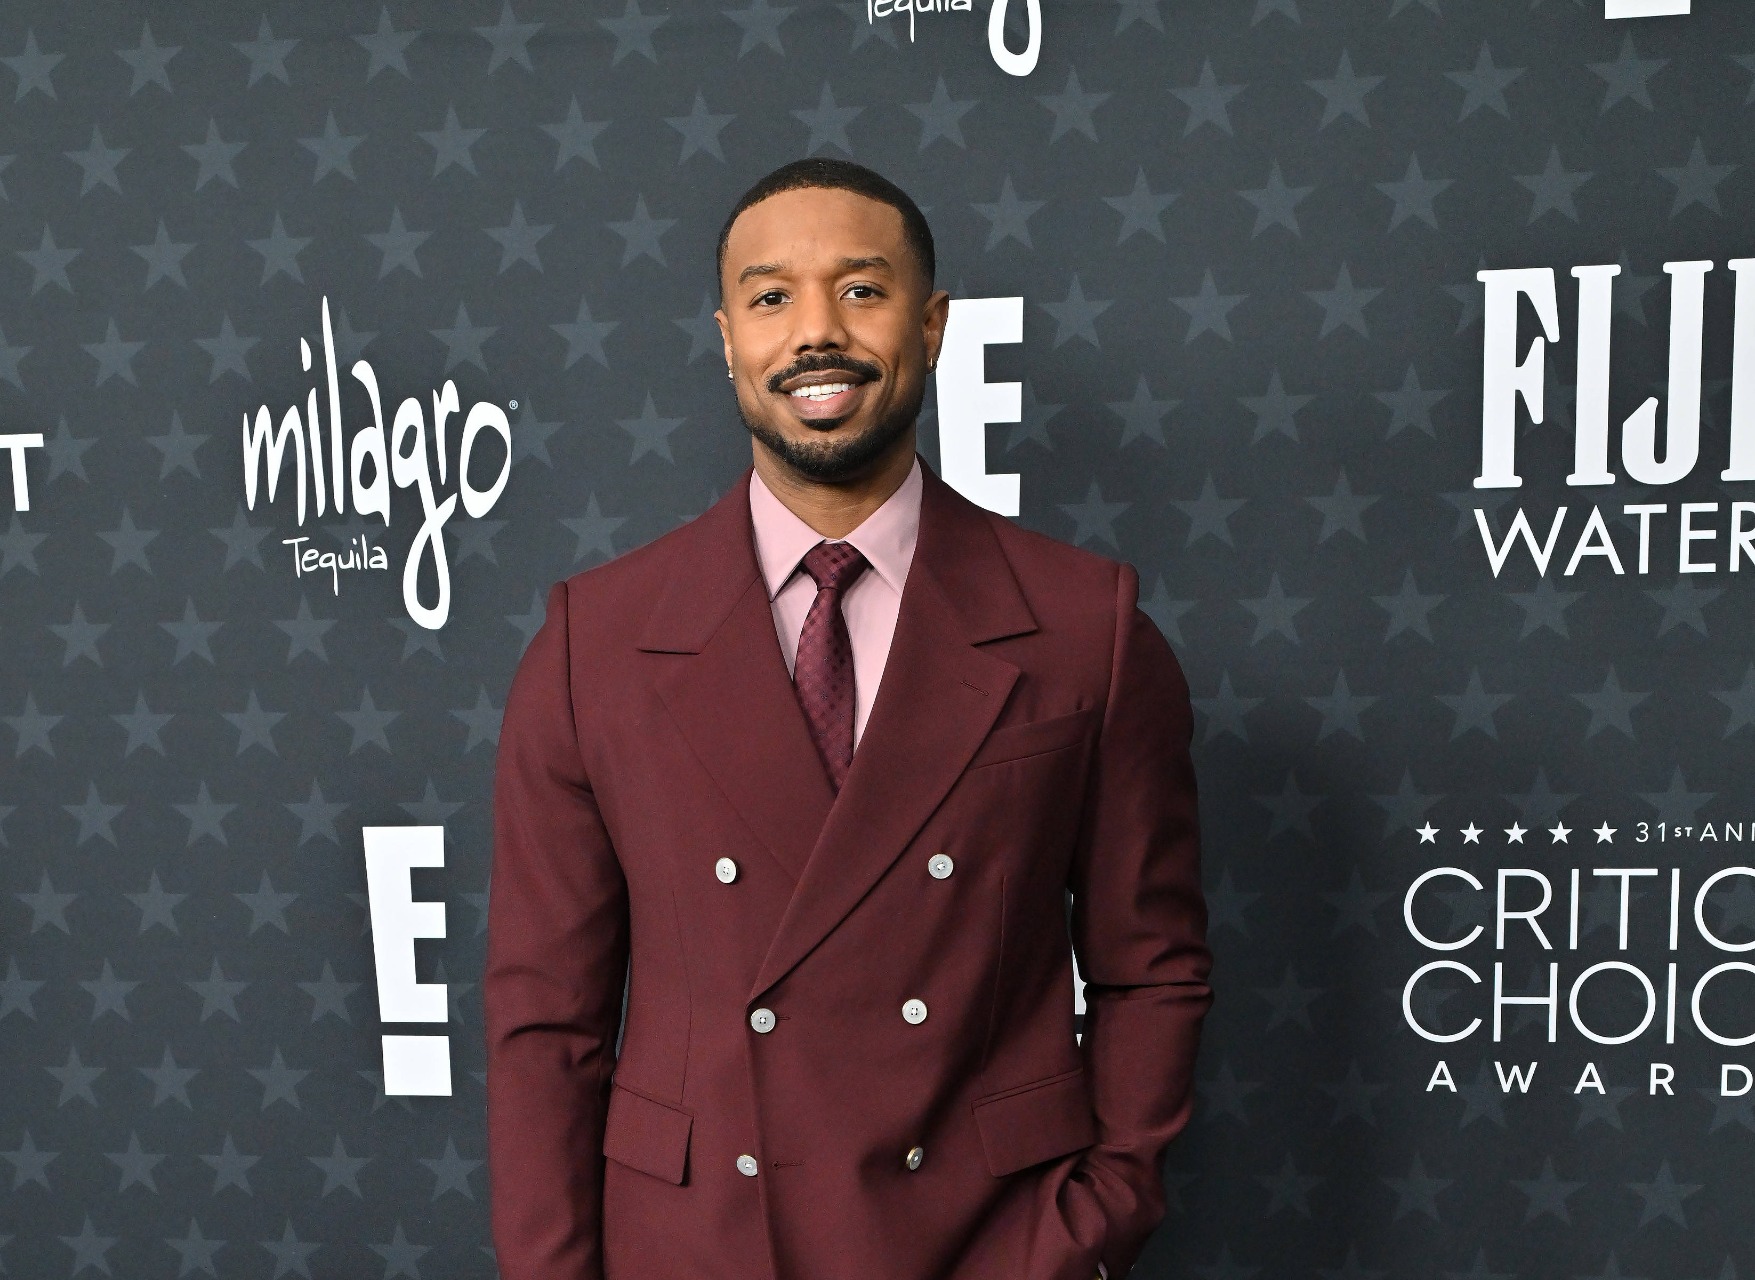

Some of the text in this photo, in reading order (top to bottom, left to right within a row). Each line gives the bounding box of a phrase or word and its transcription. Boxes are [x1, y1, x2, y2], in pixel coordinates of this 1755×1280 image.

[242, 295, 512, 630] milagro
[282, 534, 389, 597] Tequila
[1473, 502, 1755, 578] WATER
[1403, 866, 1755, 952] CRITIC
[1402, 961, 1755, 1047] CHOIC
[1425, 1060, 1754, 1097] AWARD
